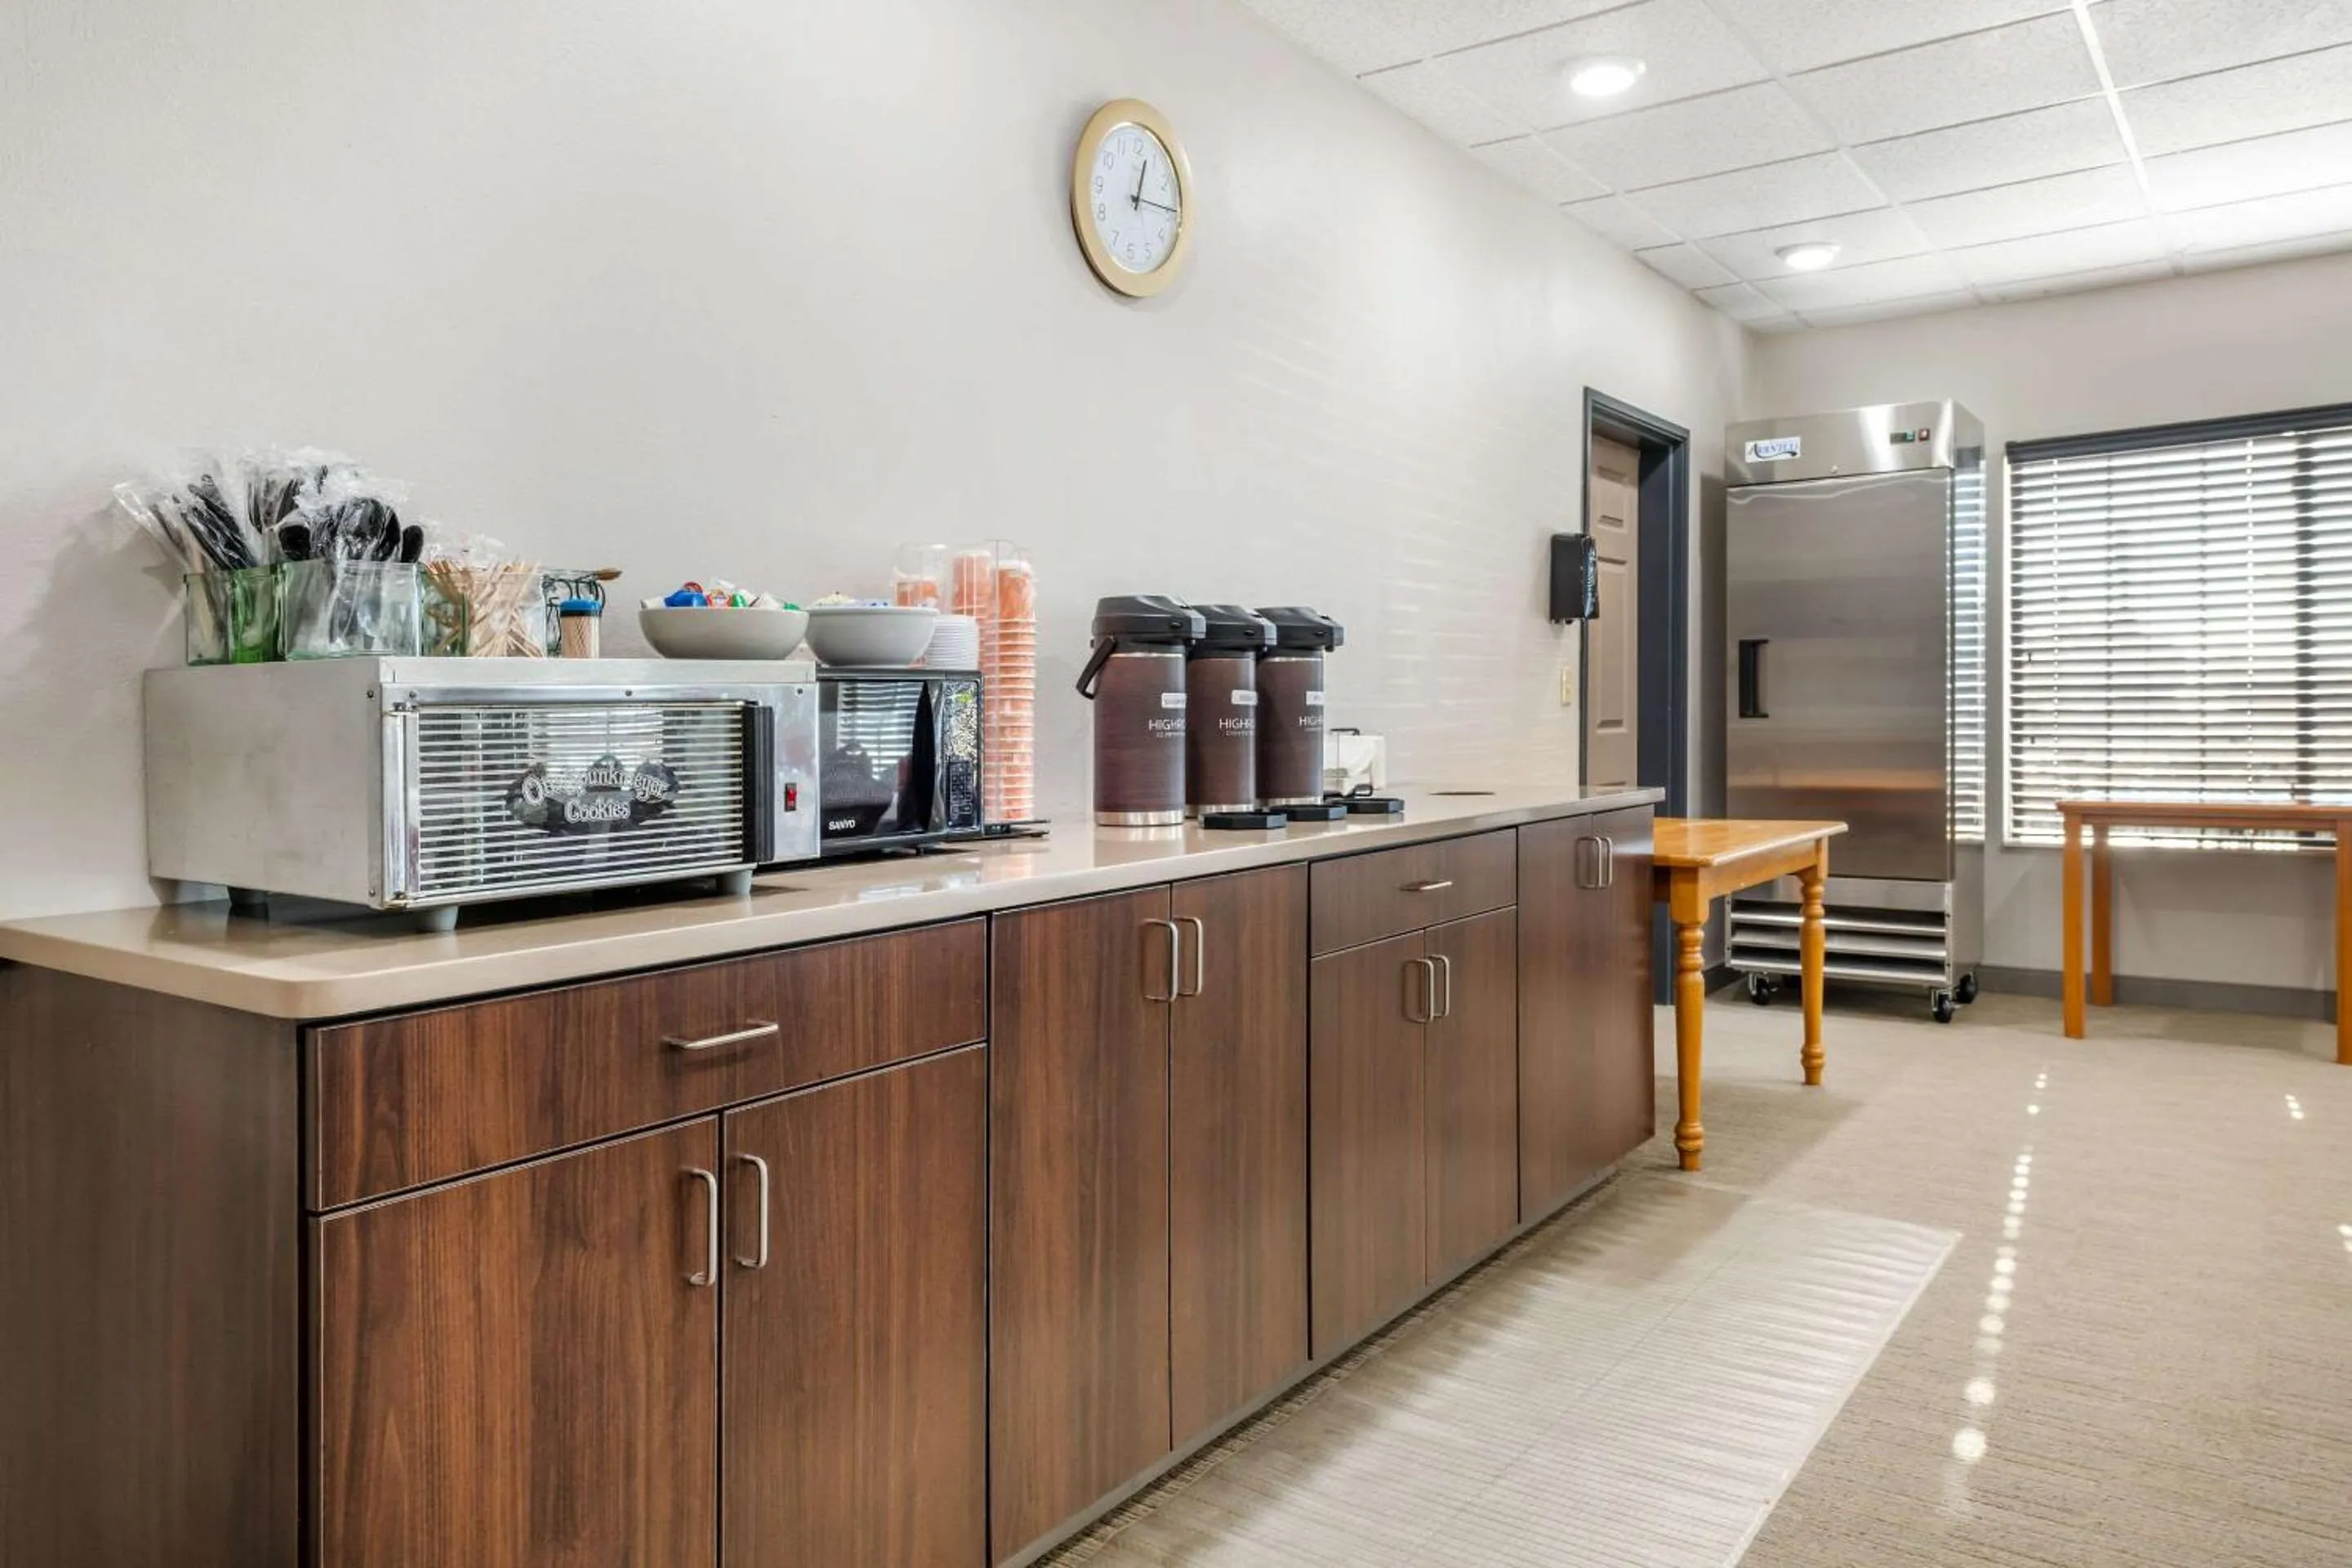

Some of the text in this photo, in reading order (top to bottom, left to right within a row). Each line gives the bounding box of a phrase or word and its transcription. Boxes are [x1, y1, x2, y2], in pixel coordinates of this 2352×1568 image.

[1117, 138, 1125, 157] 11
[1133, 139, 1144, 155] 12
[1103, 150, 1114, 170] 10
[1095, 176, 1103, 194] 9
[1097, 203, 1106, 222] 8
[1112, 229, 1120, 247] 7
[1126, 243, 1134, 260] 6
[1144, 243, 1152, 260] 5
[566, 797, 630, 823] Cookies
[828, 819, 856, 831] SANYO
